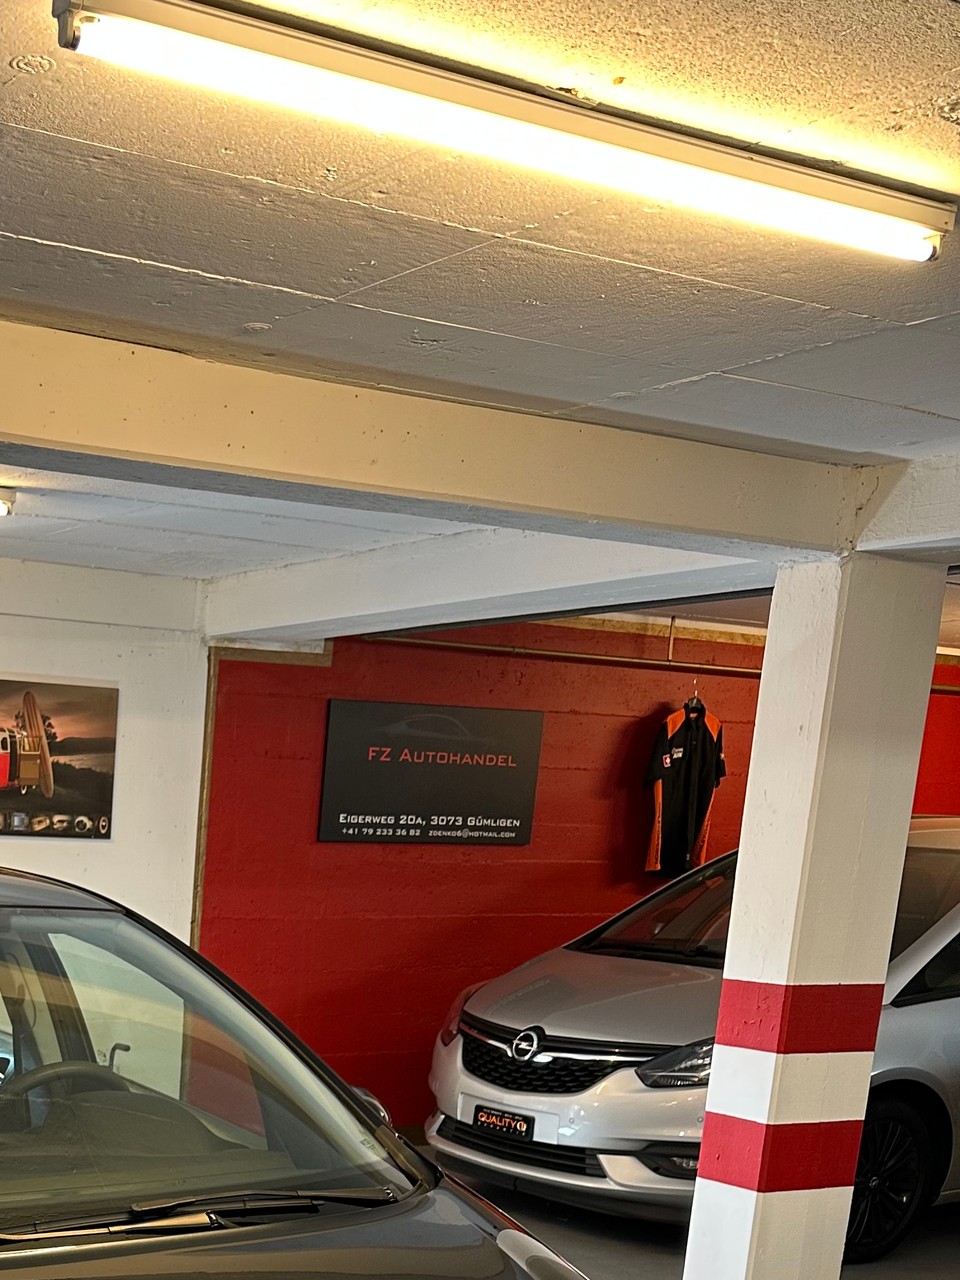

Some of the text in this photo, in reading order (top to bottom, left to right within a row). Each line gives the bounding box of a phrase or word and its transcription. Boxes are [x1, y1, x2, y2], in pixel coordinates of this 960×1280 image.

[368, 747, 517, 767] FZ AUTOHANDEL
[339, 813, 520, 827] EIGERWEG 20A, 3073 GÜMLIGEN
[342, 827, 358, 835] +41
[362, 828, 374, 836] 79
[376, 828, 393, 836] 233
[396, 828, 407, 836] 36
[478, 1112, 517, 1128] QUALITY
